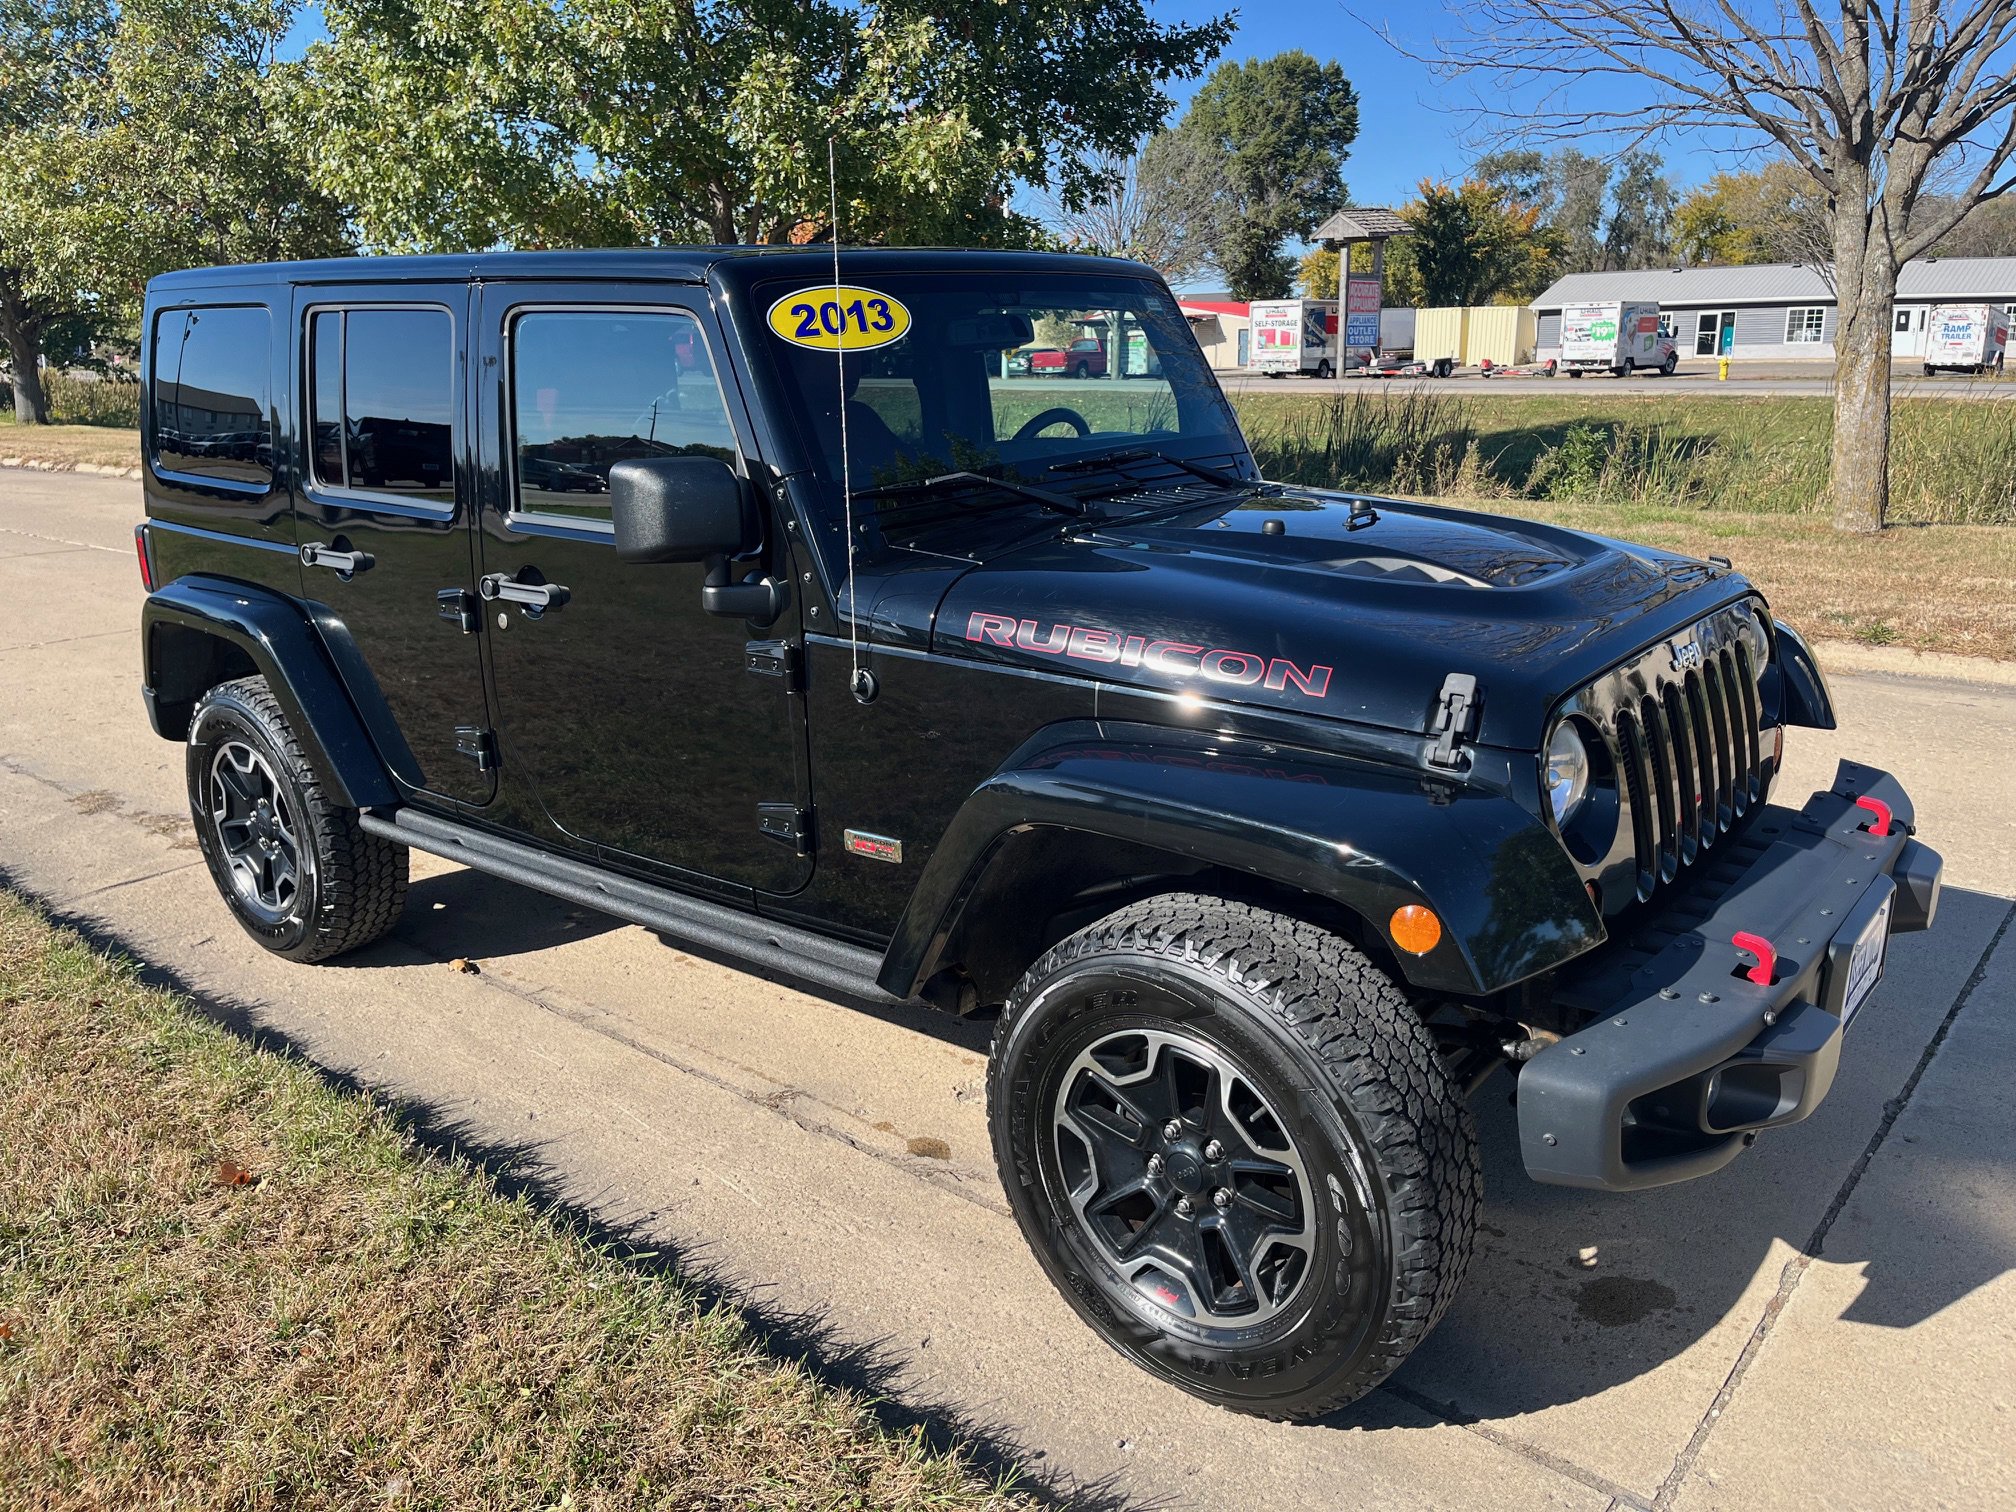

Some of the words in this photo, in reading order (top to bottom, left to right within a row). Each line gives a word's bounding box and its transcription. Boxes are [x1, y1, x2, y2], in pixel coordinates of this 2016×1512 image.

[791, 299, 896, 339] 2013
[1254, 320, 1298, 328] SELF-STORAGE
[1349, 315, 1377, 325] APPLIANCE
[1348, 326, 1377, 335] OUTLET
[1349, 335, 1375, 344] STORE
[965, 611, 1334, 698] RUBICON
[1672, 641, 1701, 671] Jeep
